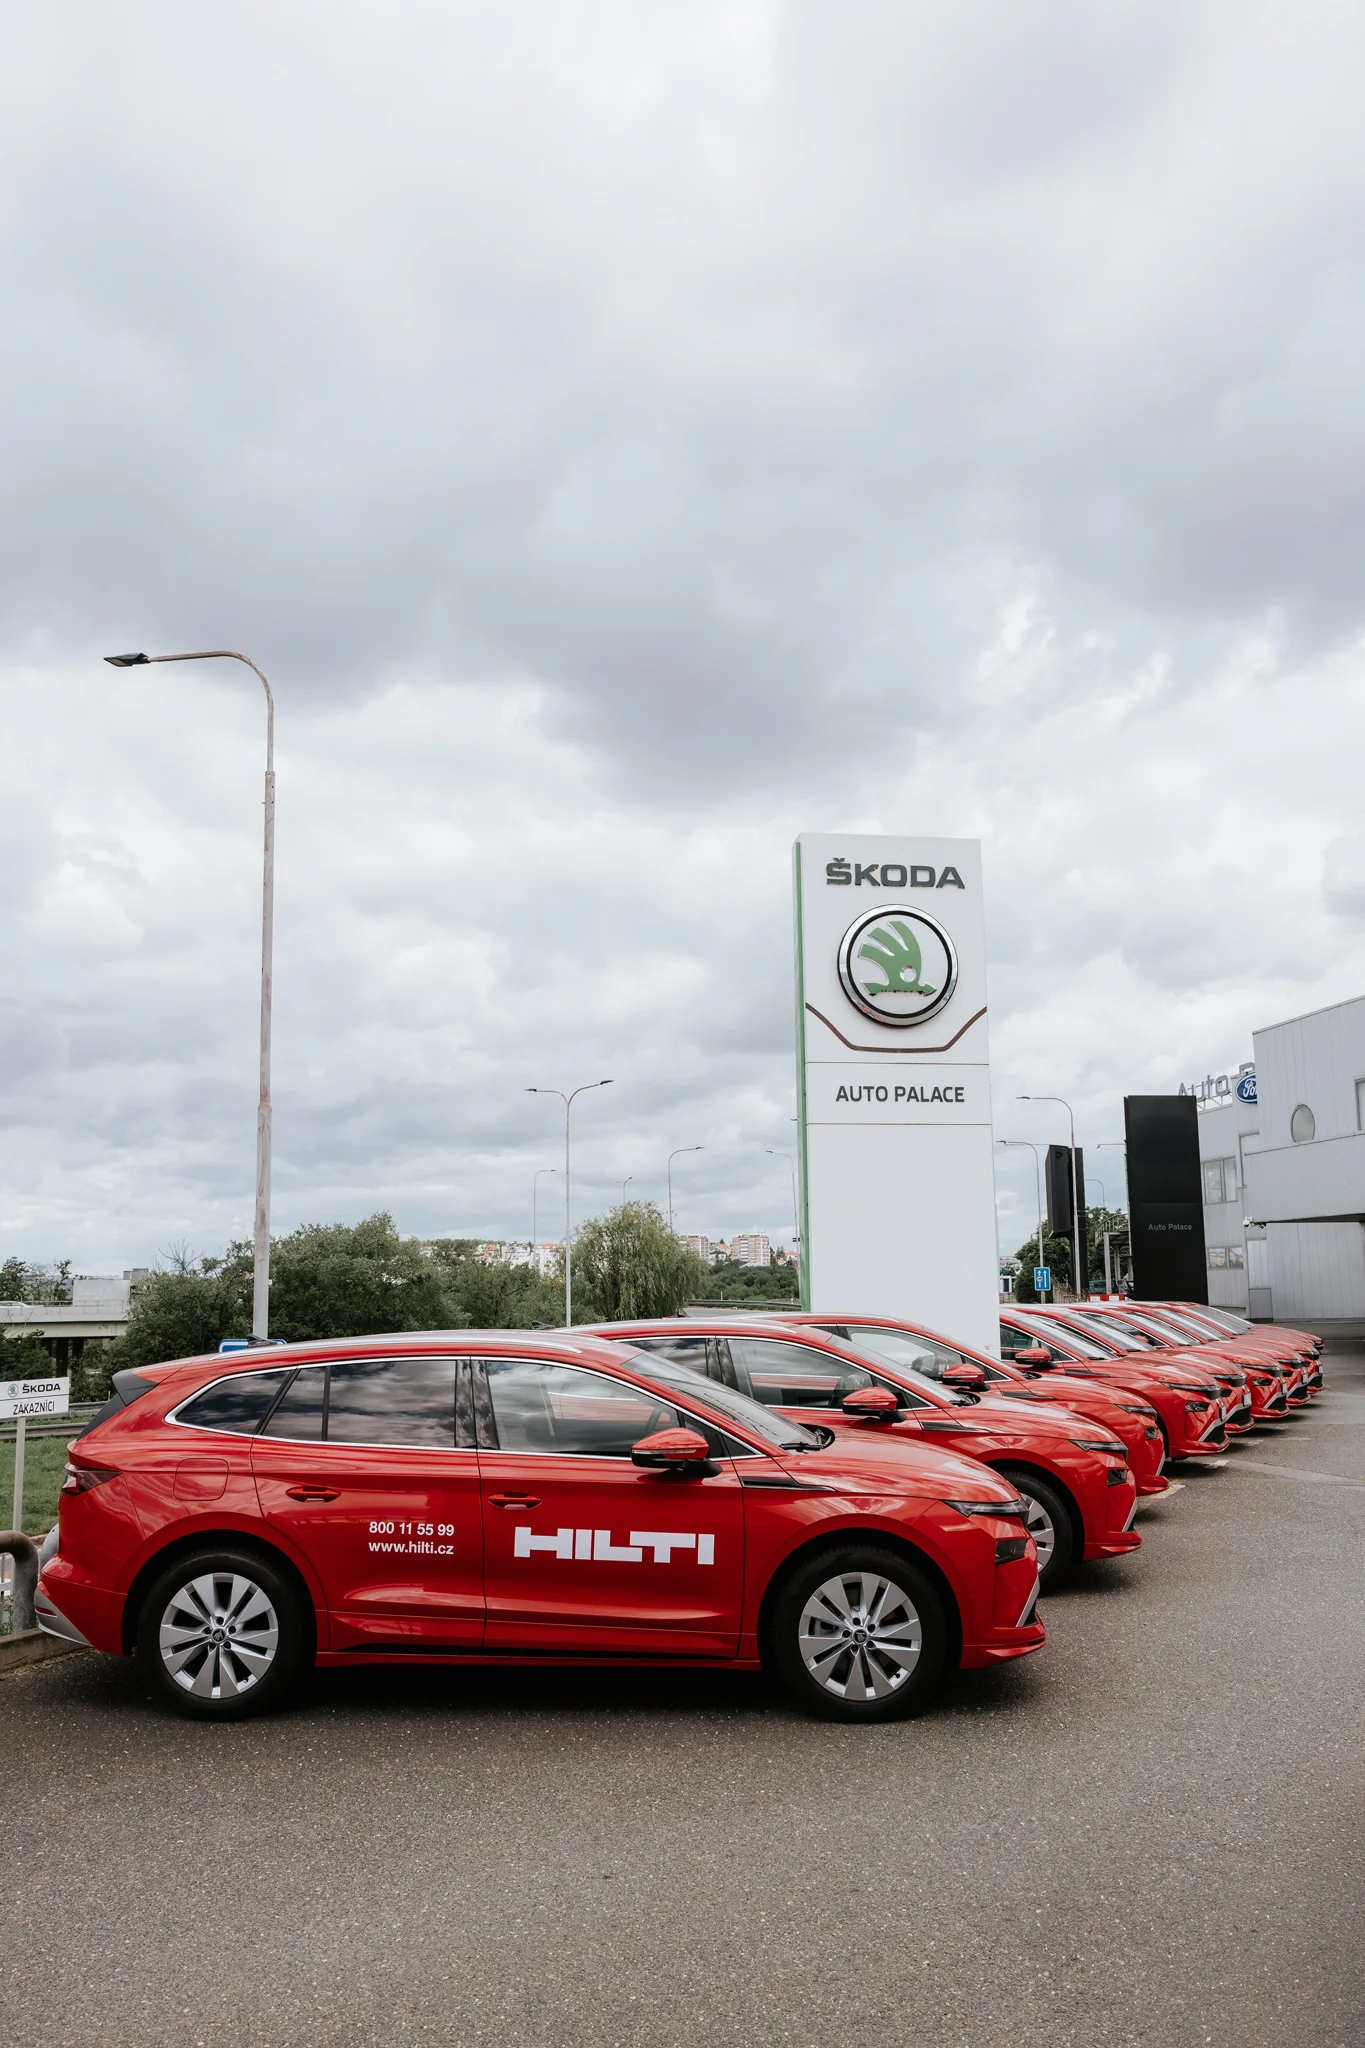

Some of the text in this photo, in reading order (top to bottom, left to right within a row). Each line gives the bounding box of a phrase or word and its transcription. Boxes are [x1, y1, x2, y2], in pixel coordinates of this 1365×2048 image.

[826, 858, 965, 889] ŠKODA
[835, 1085, 965, 1103] AUTO PALACE
[1148, 1223, 1193, 1231] Auto Palace
[22, 1383, 61, 1394] ŠKODA
[13, 1399, 55, 1415] ZÁKAZNÍCI
[369, 1521, 455, 1537] 800 11 55 99
[368, 1540, 454, 1555] www.hilti.cz
[513, 1526, 715, 1565] HILTI
